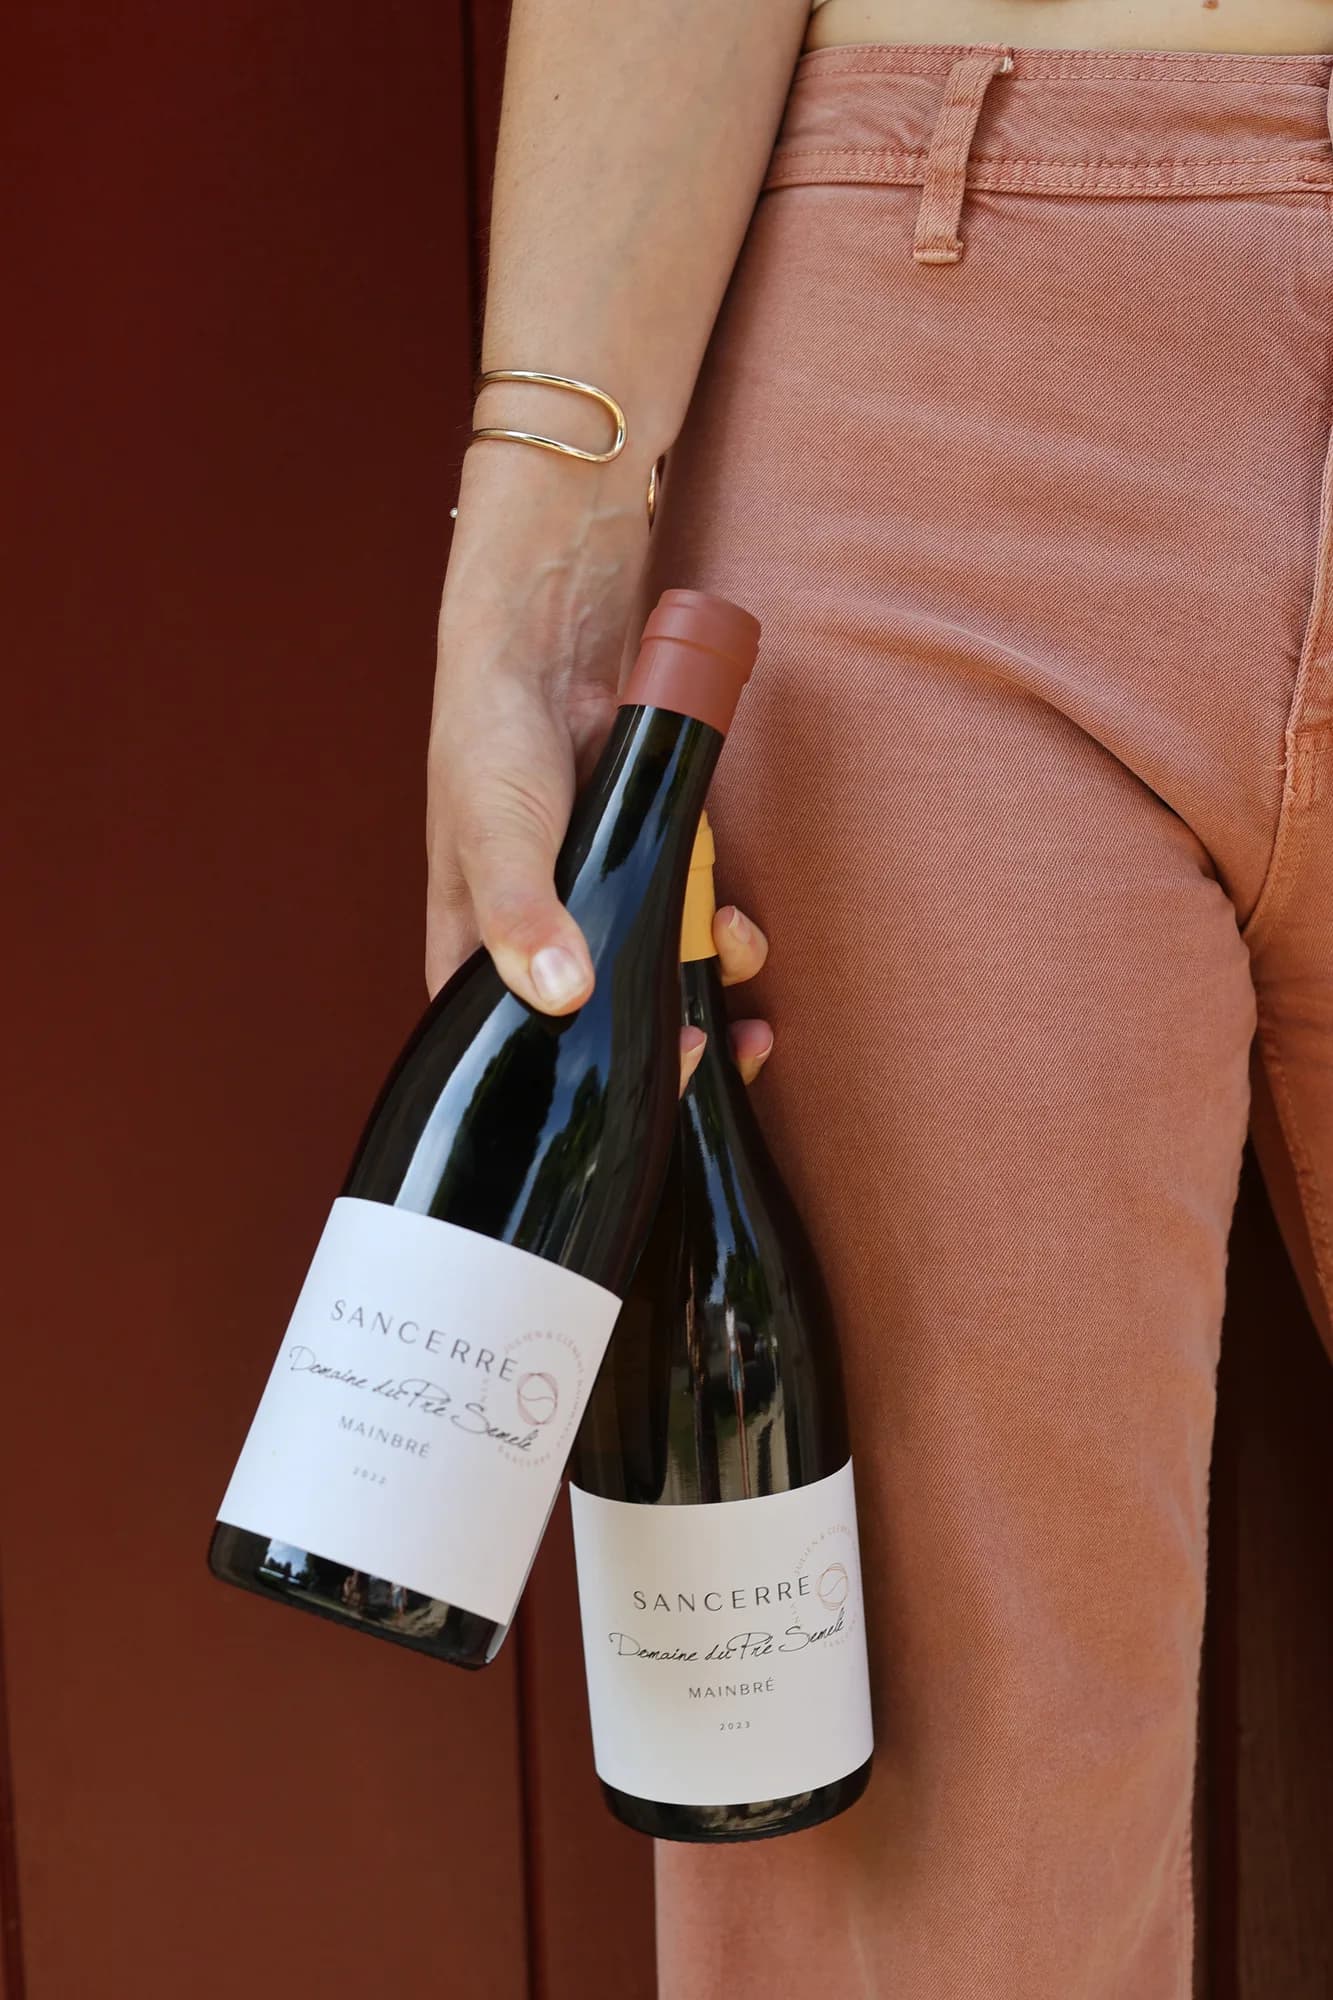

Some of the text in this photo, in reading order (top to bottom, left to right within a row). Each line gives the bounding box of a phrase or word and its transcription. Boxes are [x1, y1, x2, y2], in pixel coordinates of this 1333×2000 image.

[331, 1299, 519, 1382] SANCERRE
[289, 1345, 365, 1390] Domaine
[371, 1379, 402, 1400] du
[338, 1415, 431, 1458] MAINBRÉ
[632, 1575, 811, 1613] SANCERRE
[608, 1632, 699, 1662] Domaine
[705, 1644, 733, 1661] du
[727, 1632, 774, 1661] Pré
[688, 1677, 776, 1699] MAINBRÉ
[719, 1720, 751, 1732] 2023
